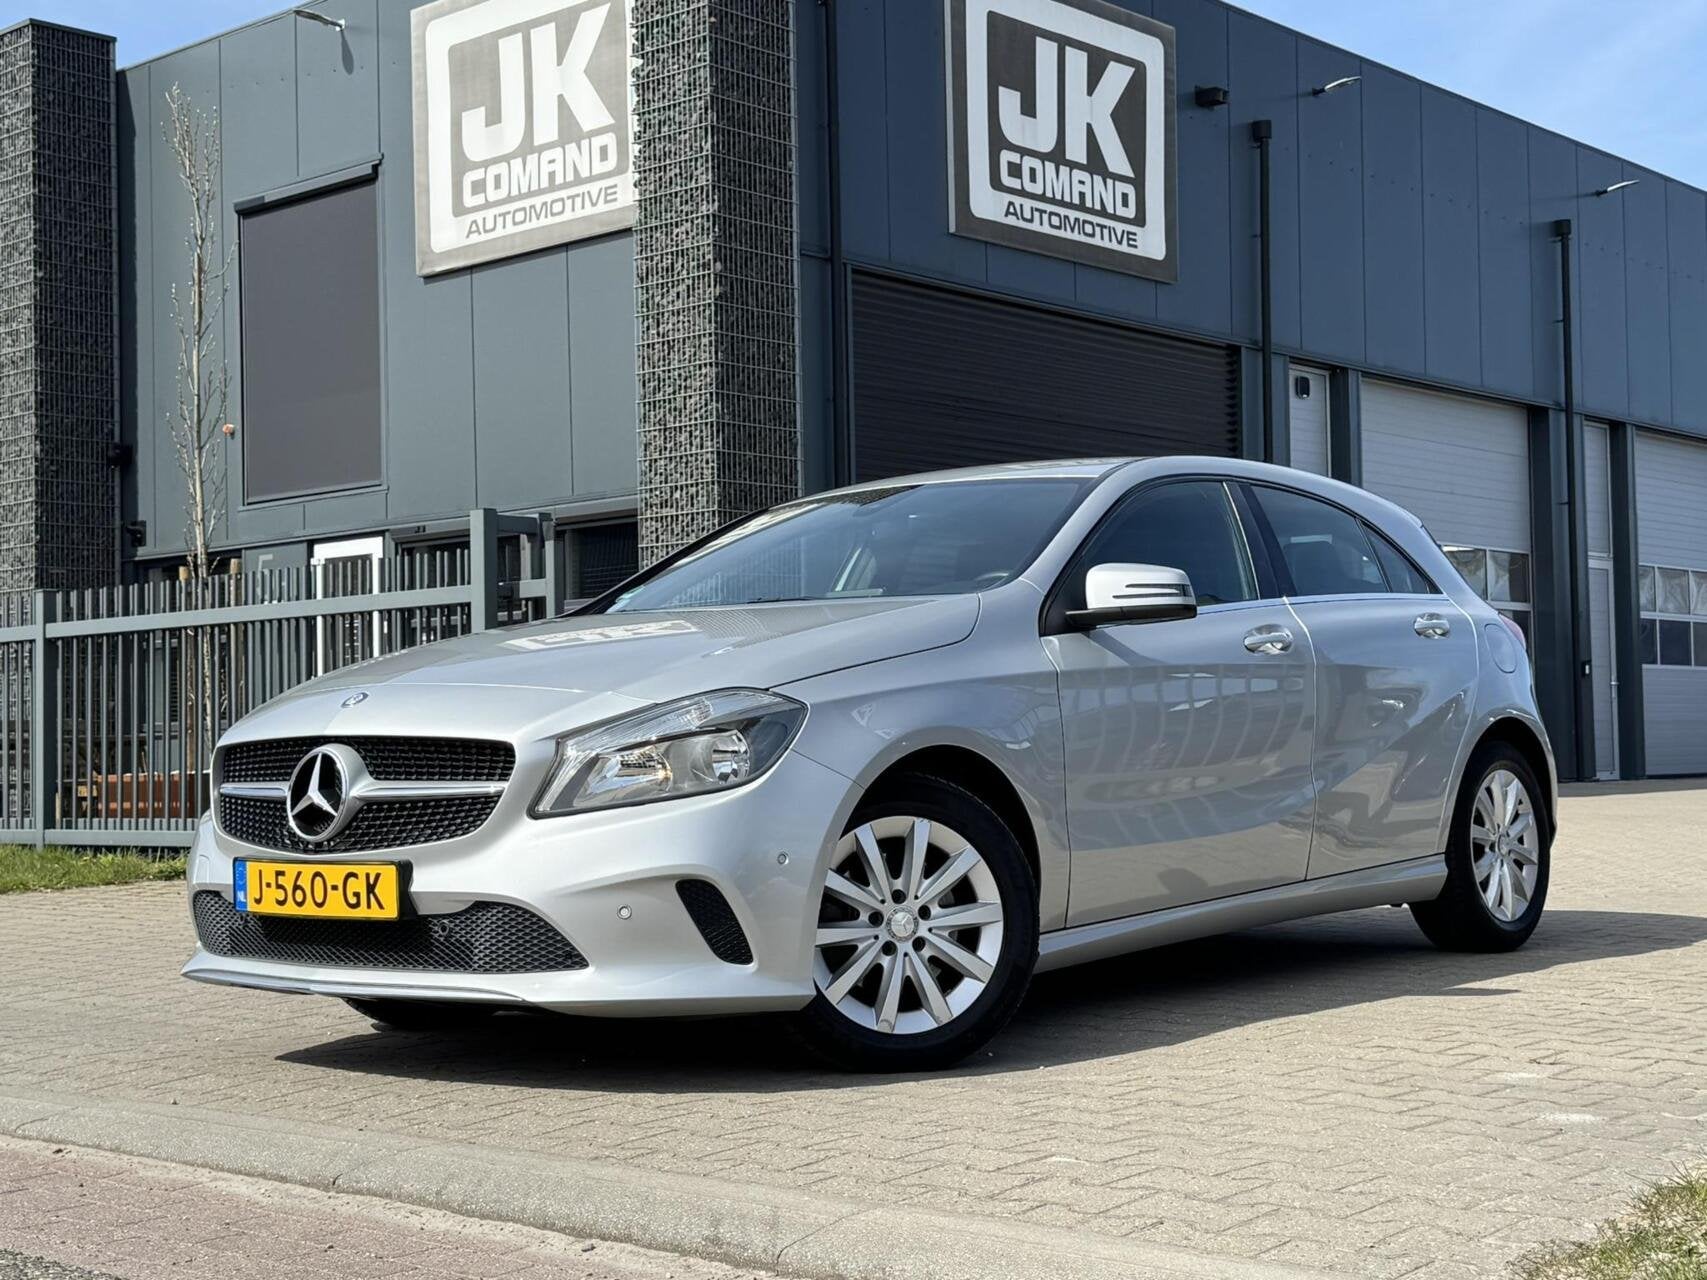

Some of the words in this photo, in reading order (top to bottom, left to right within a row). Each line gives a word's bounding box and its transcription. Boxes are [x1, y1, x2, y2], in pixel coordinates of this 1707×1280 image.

[462, 2, 615, 162] JK
[998, 36, 1135, 178] JK
[462, 132, 618, 208] COMAND
[1000, 149, 1136, 219] COMAND
[465, 184, 618, 239] AUTOMOTIVE
[1004, 201, 1138, 249] AUTOMOTIVE
[254, 869, 385, 910] J-560-GK
